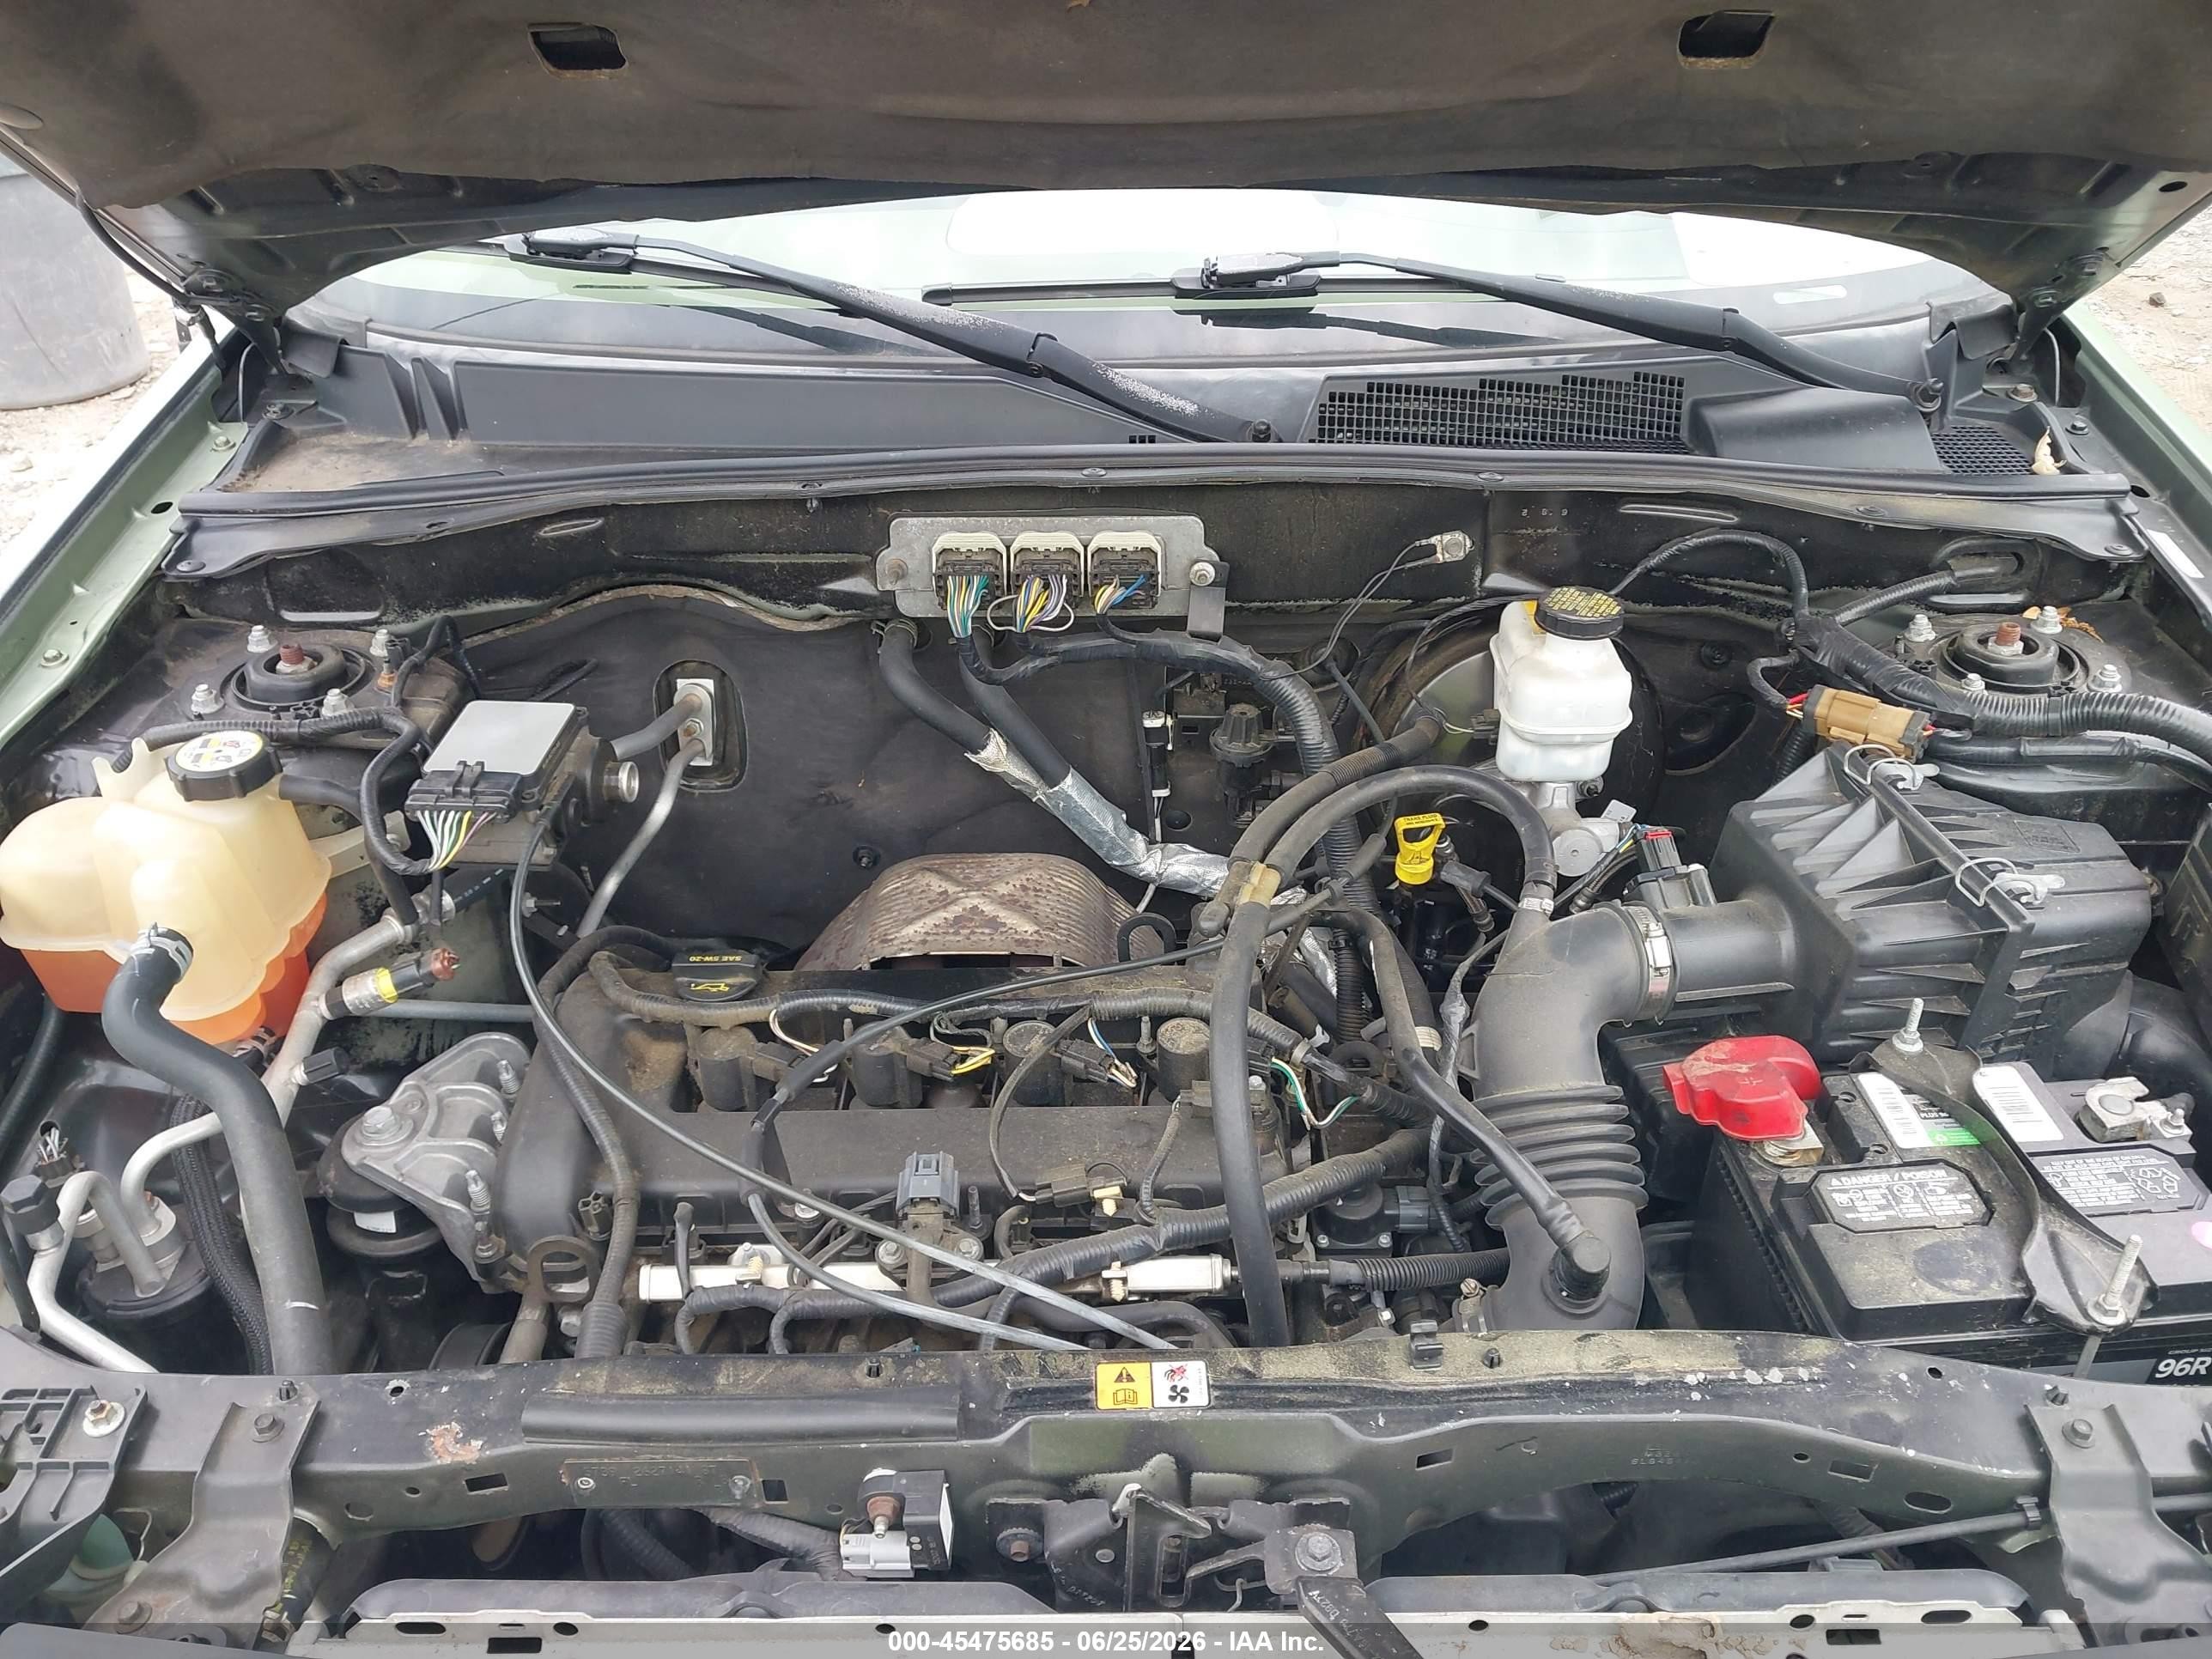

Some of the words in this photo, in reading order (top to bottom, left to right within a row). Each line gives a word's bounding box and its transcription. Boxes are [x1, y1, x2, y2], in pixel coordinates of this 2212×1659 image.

[1840, 1173, 1893, 1186] DANGER
[1903, 1169, 1948, 1181] POISON
[2154, 1357, 2212, 1378] 96R
